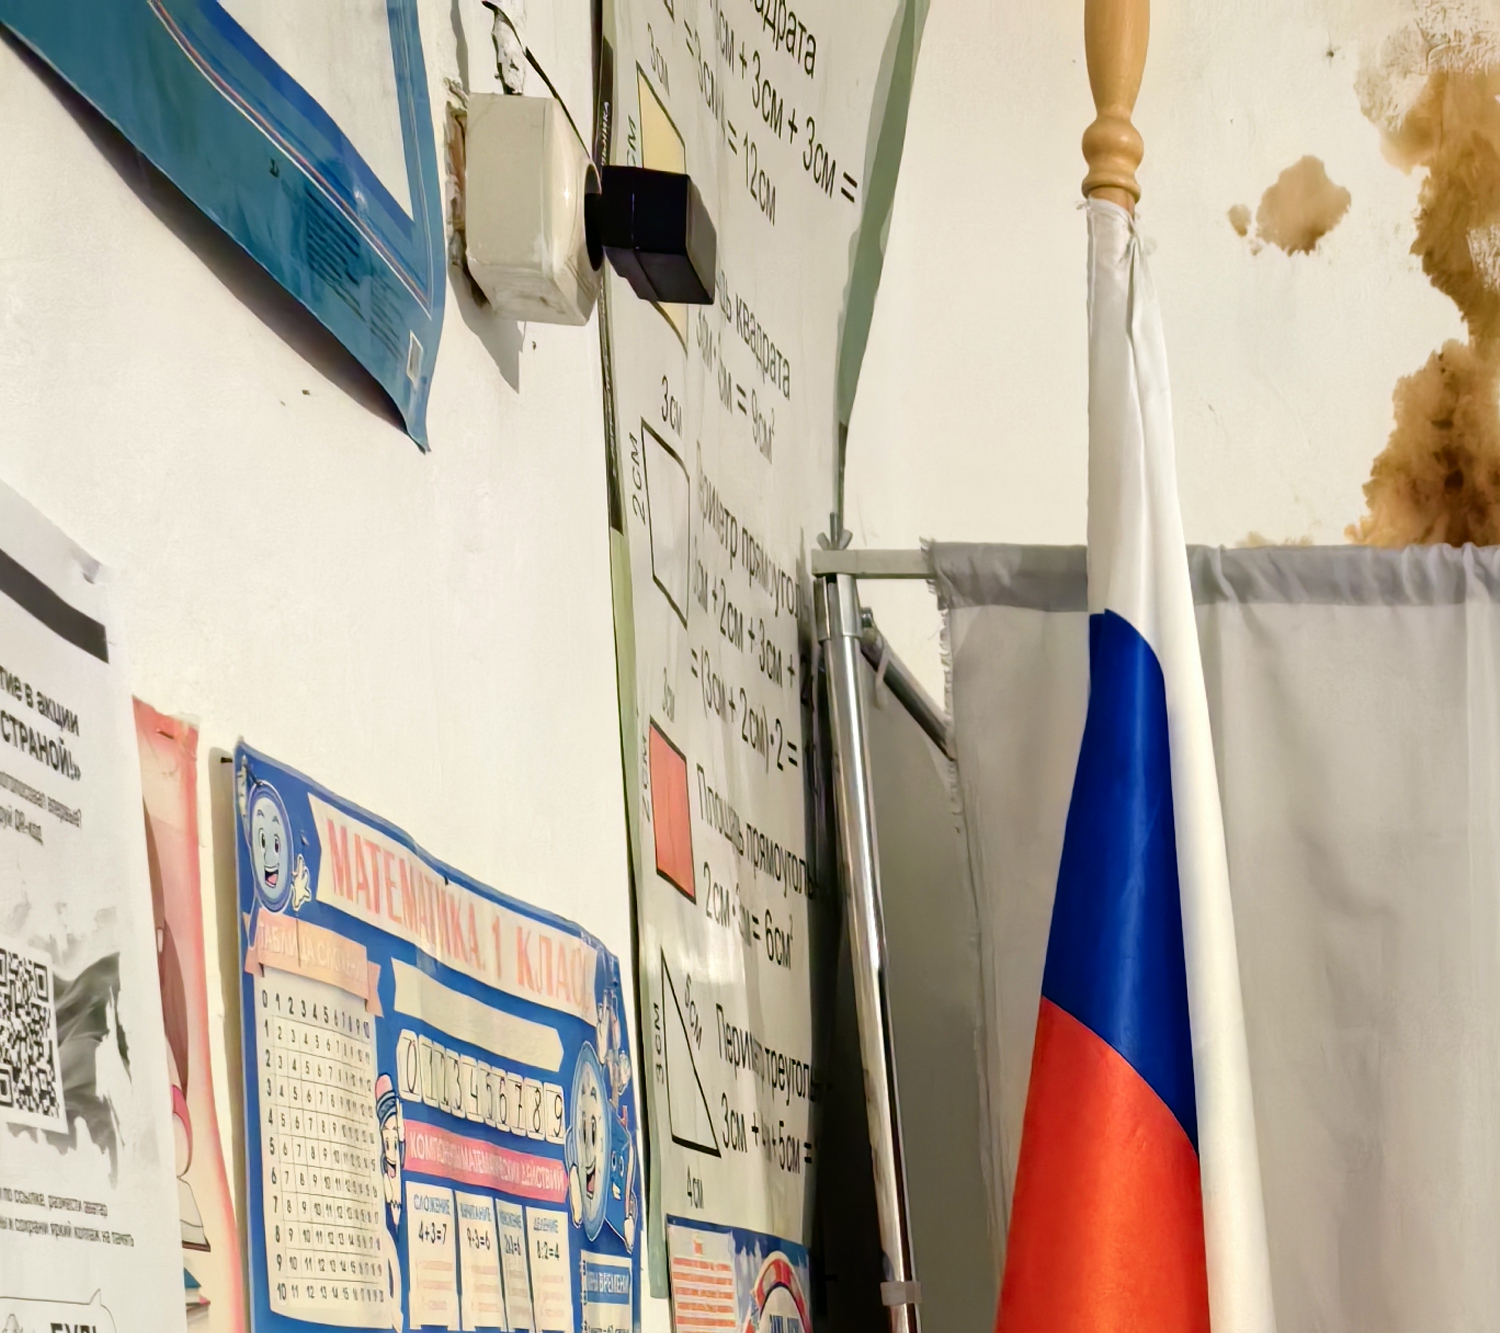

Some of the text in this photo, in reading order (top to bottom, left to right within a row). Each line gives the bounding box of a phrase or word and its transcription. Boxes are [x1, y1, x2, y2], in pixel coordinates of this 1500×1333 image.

[803, 116, 836, 199] 3см
[736, 293, 790, 401] квадрата
[36, 691, 80, 737] акции
[326, 817, 485, 972] МАТЕМАТИКА
